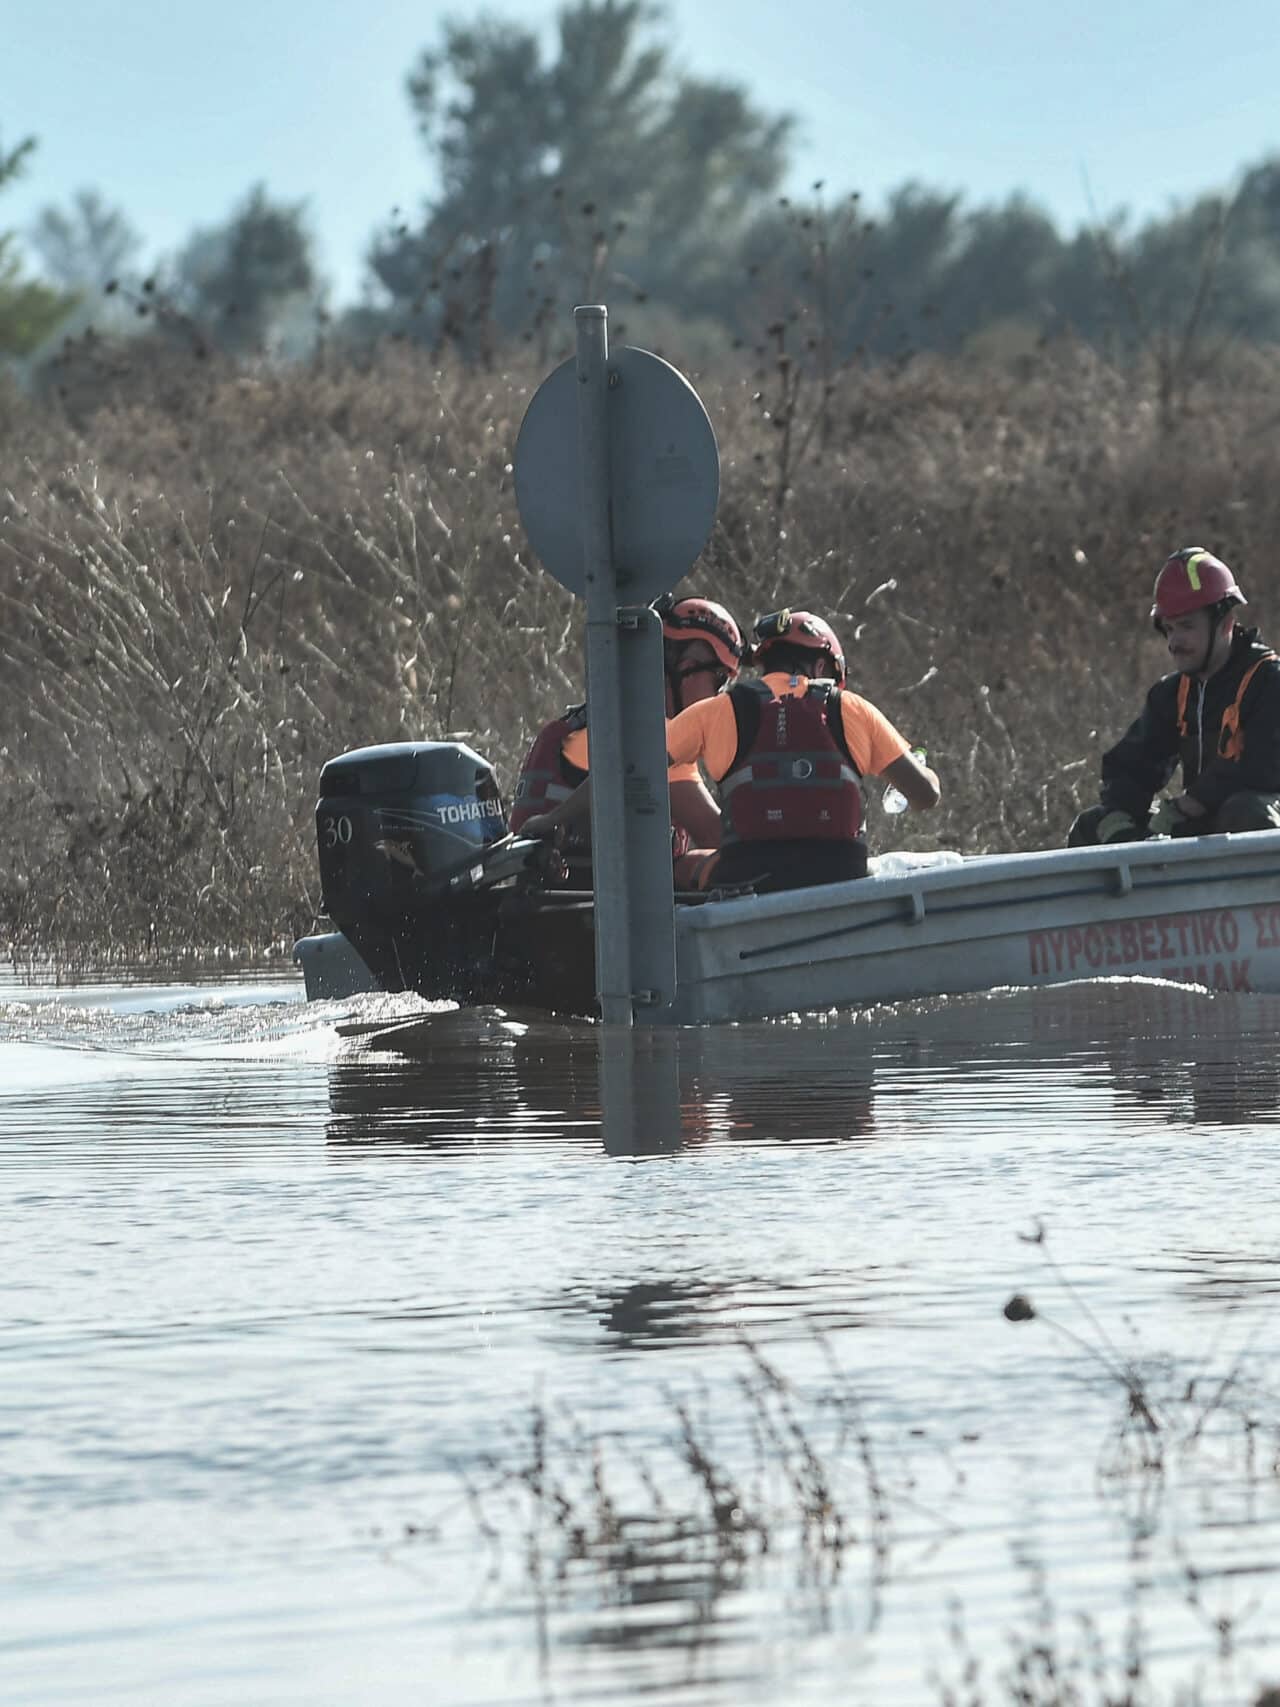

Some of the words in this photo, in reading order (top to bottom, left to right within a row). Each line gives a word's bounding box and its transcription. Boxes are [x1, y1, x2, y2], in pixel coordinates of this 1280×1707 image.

[437, 798, 502, 824] TOHATSU
[325, 815, 352, 848] 30
[1028, 911, 1239, 976] ΠΥΡΟΣΒΕΣΤΙΚΟ
